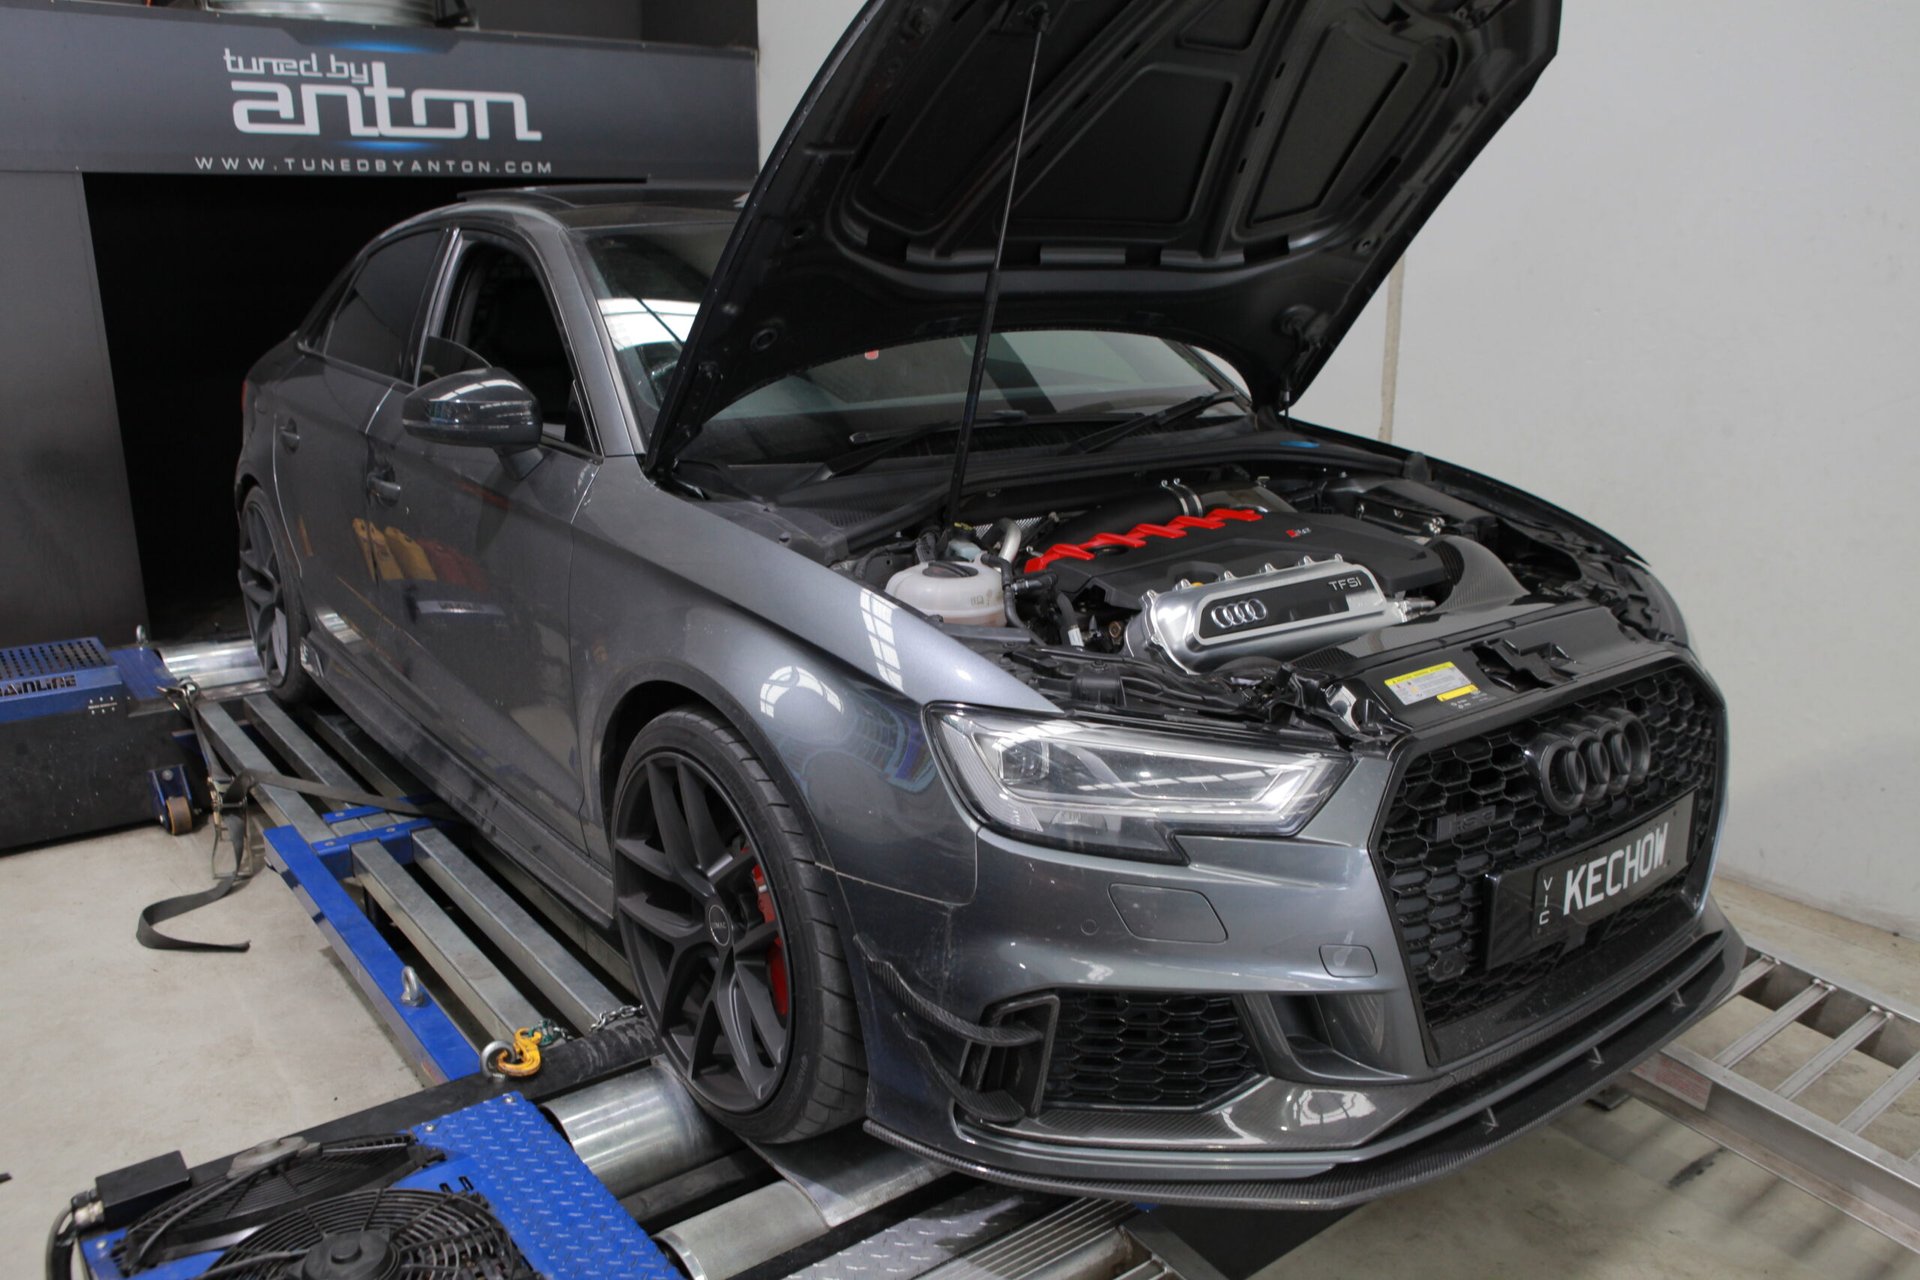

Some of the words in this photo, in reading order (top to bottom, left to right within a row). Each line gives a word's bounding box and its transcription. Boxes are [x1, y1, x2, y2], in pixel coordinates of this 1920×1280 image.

[223, 48, 322, 77] tuned
[326, 54, 369, 84] by
[231, 61, 542, 141] anton
[195, 157, 552, 174] WWW.TUNEDBYANTON.COM
[1328, 576, 1362, 591] TFSI
[0, 675, 77, 696] AINLINE
[1563, 822, 1669, 916] KECHOW
